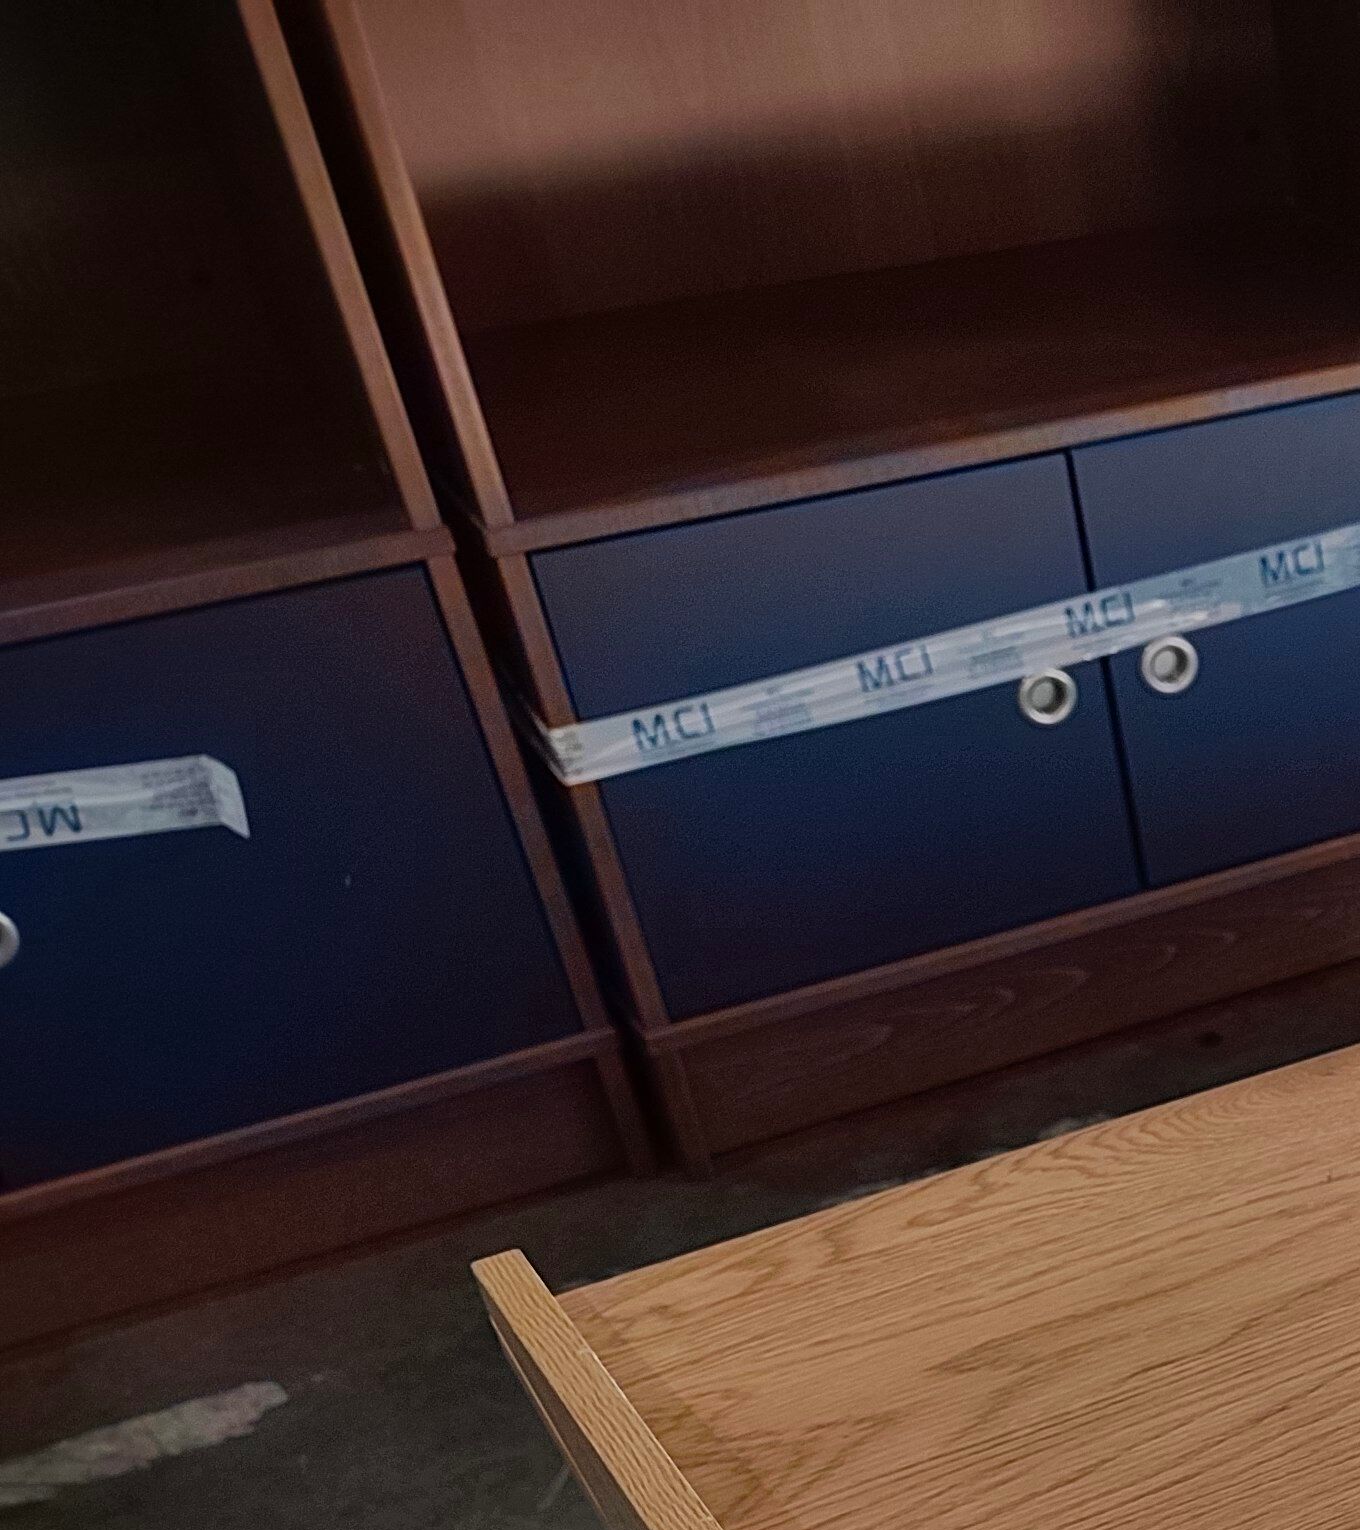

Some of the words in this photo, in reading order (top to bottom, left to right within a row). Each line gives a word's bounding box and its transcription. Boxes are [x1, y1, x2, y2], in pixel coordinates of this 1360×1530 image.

[632, 702, 716, 750] MCI
[858, 644, 933, 692] MCI
[1065, 592, 1135, 637] MCI
[1259, 543, 1324, 584] MCI
[0, 803, 83, 842] MC
